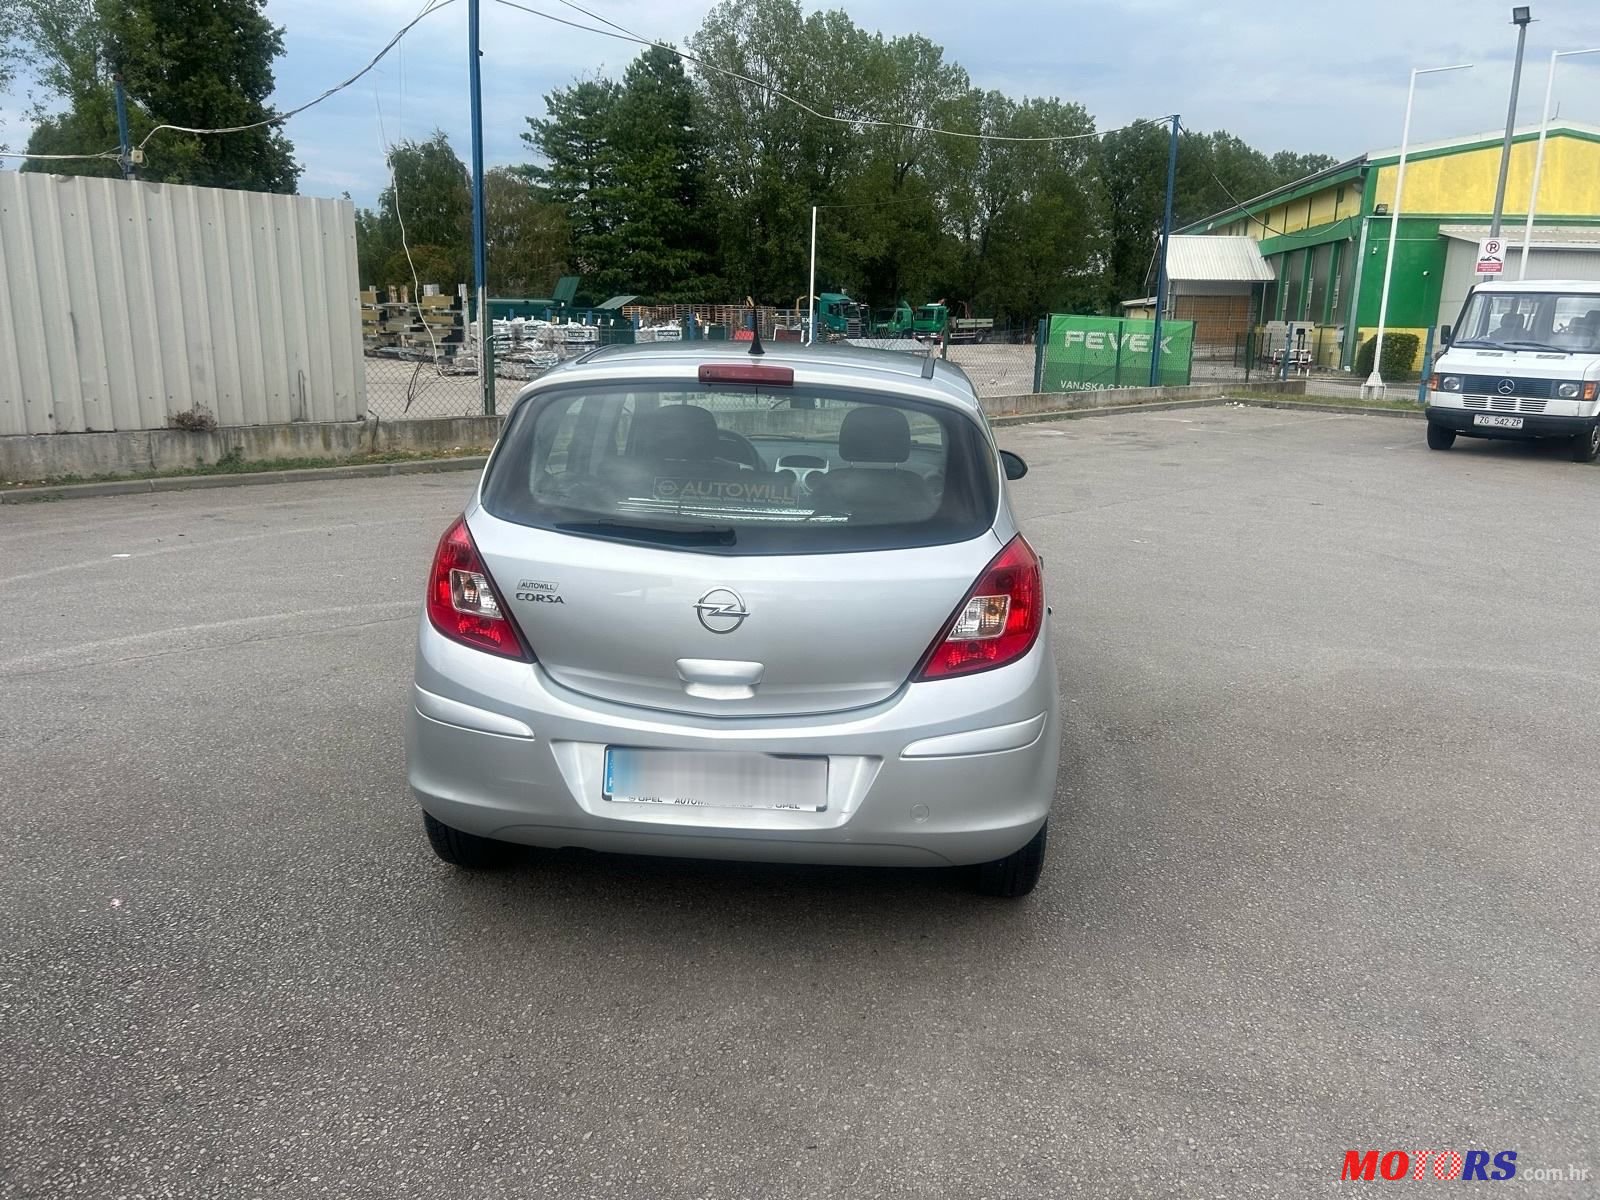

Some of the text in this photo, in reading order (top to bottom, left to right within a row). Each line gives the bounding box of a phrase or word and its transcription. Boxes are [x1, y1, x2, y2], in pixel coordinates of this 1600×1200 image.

[1064, 330, 1174, 354] PEVEX
[1060, 379, 1105, 391] VANJSKA
[1479, 416, 1490, 425] ZG
[680, 480, 795, 501] AUTOWILL
[521, 581, 555, 591] AUTOWILL
[515, 592, 565, 604] CORSA
